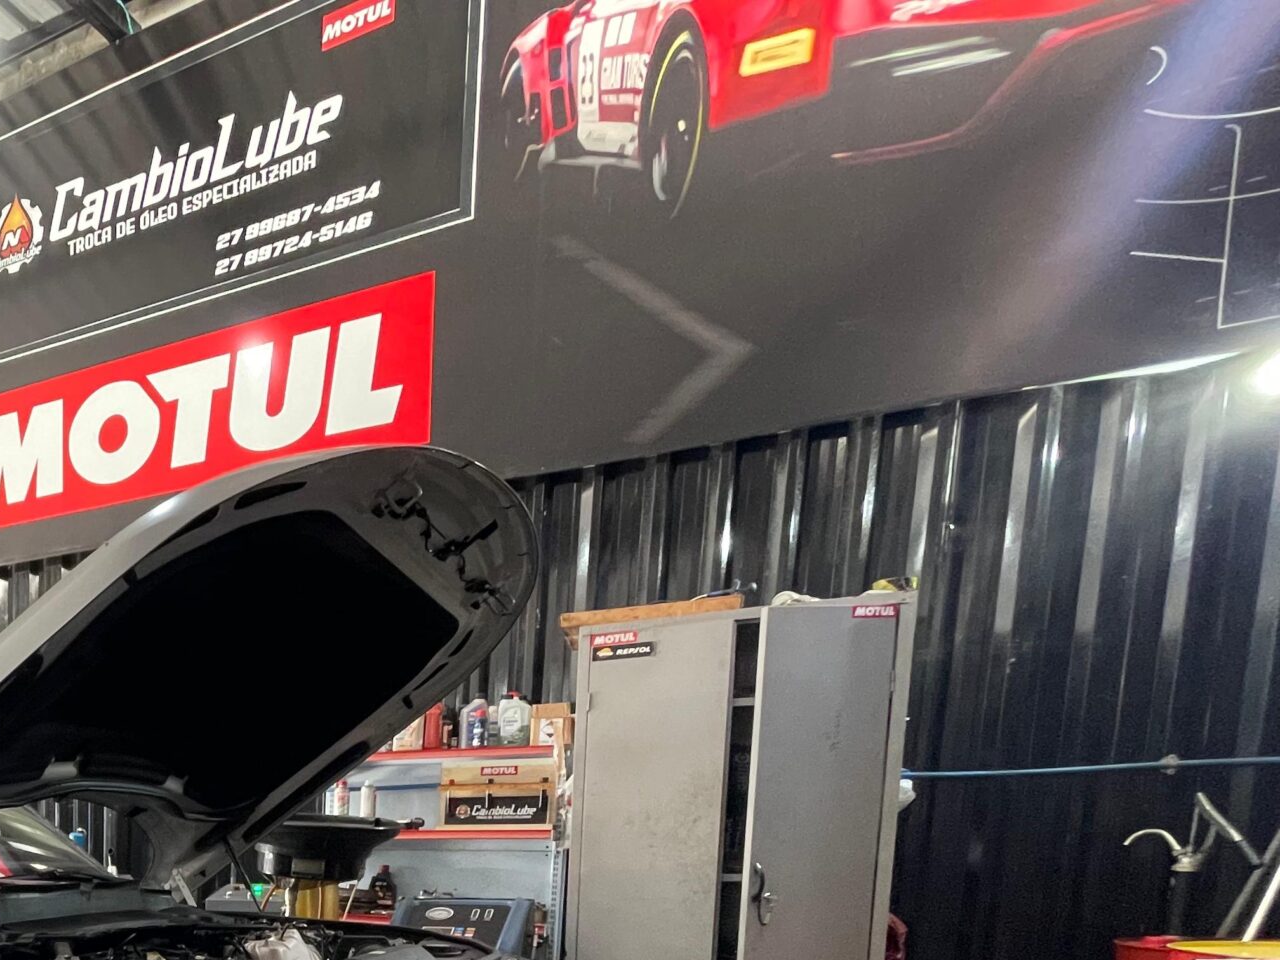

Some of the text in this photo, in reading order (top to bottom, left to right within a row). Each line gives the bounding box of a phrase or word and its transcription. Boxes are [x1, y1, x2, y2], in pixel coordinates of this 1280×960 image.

[322, 0, 392, 44] MOTUL
[49, 90, 343, 242] CambioLube
[68, 150, 317, 256] TROCA DE ÓLEO ESPECIALIZADA
[215, 227, 244, 251] 27
[214, 253, 243, 276] 27
[853, 606, 896, 617] MOTUL
[594, 632, 636, 645] MOTUL
[615, 646, 651, 656] REPSOL
[482, 766, 517, 775] MOTUL
